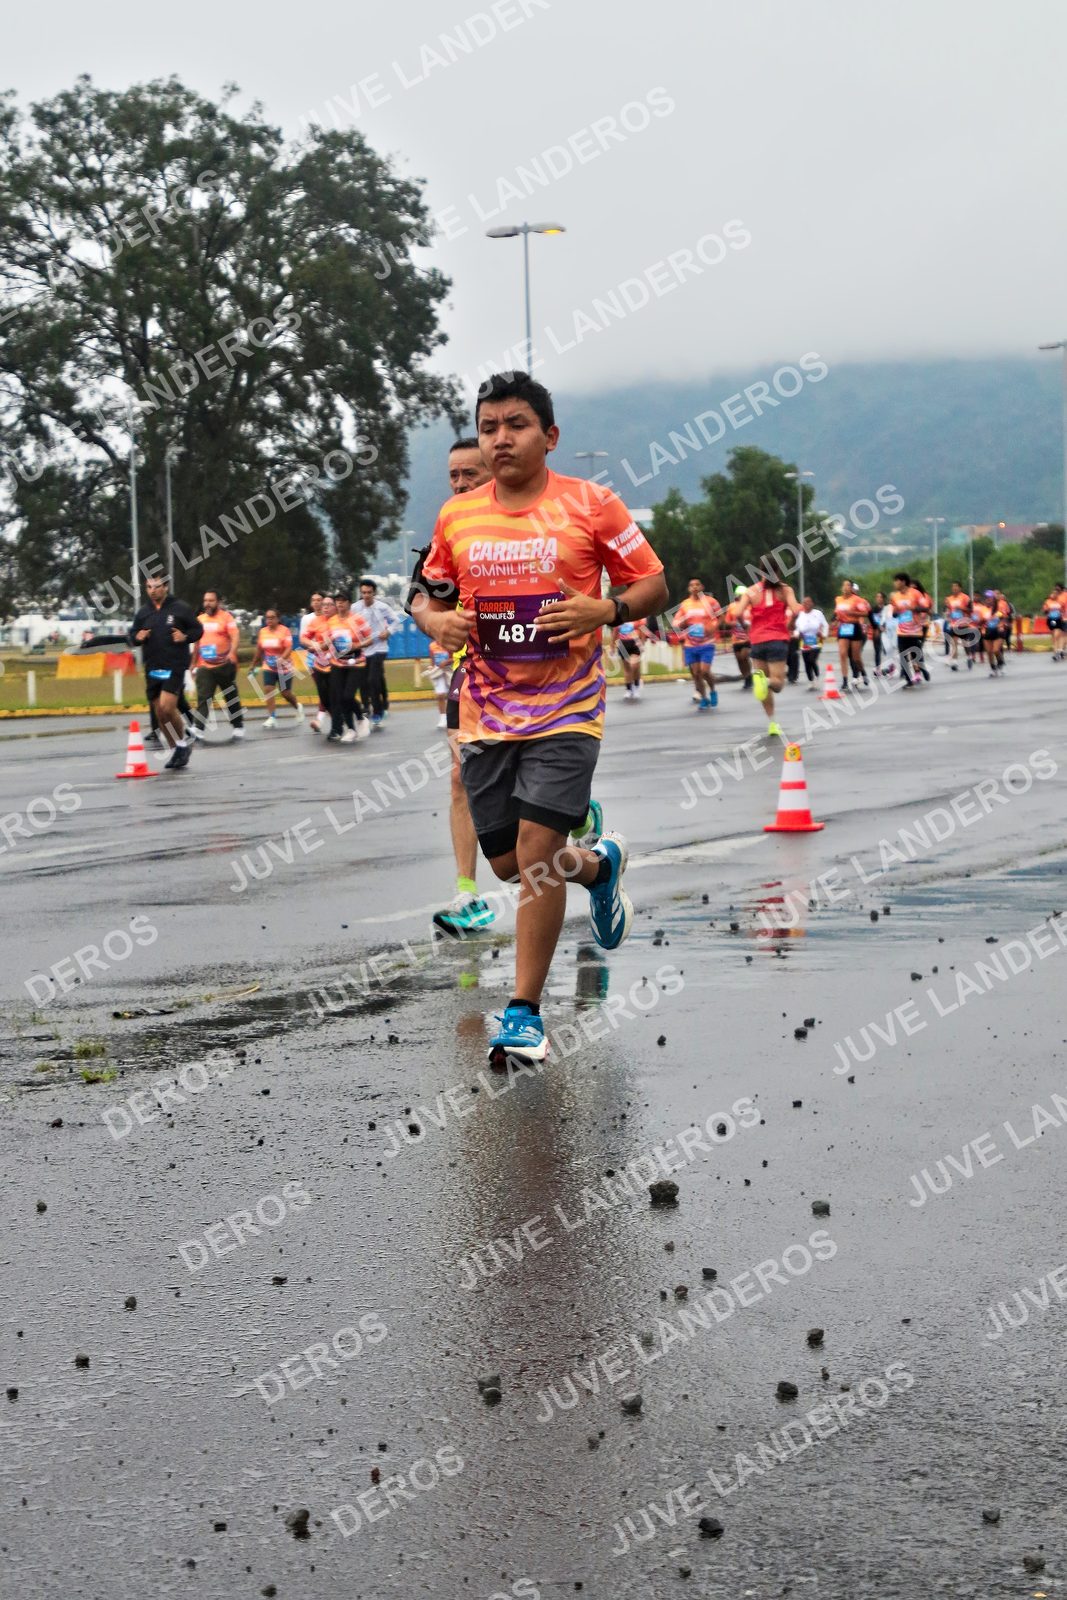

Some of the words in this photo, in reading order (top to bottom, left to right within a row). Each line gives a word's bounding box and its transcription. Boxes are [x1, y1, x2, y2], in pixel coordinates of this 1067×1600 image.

[469, 537, 558, 562] CARRERA
[480, 601, 515, 612] CARRERA
[498, 624, 537, 643] 487
